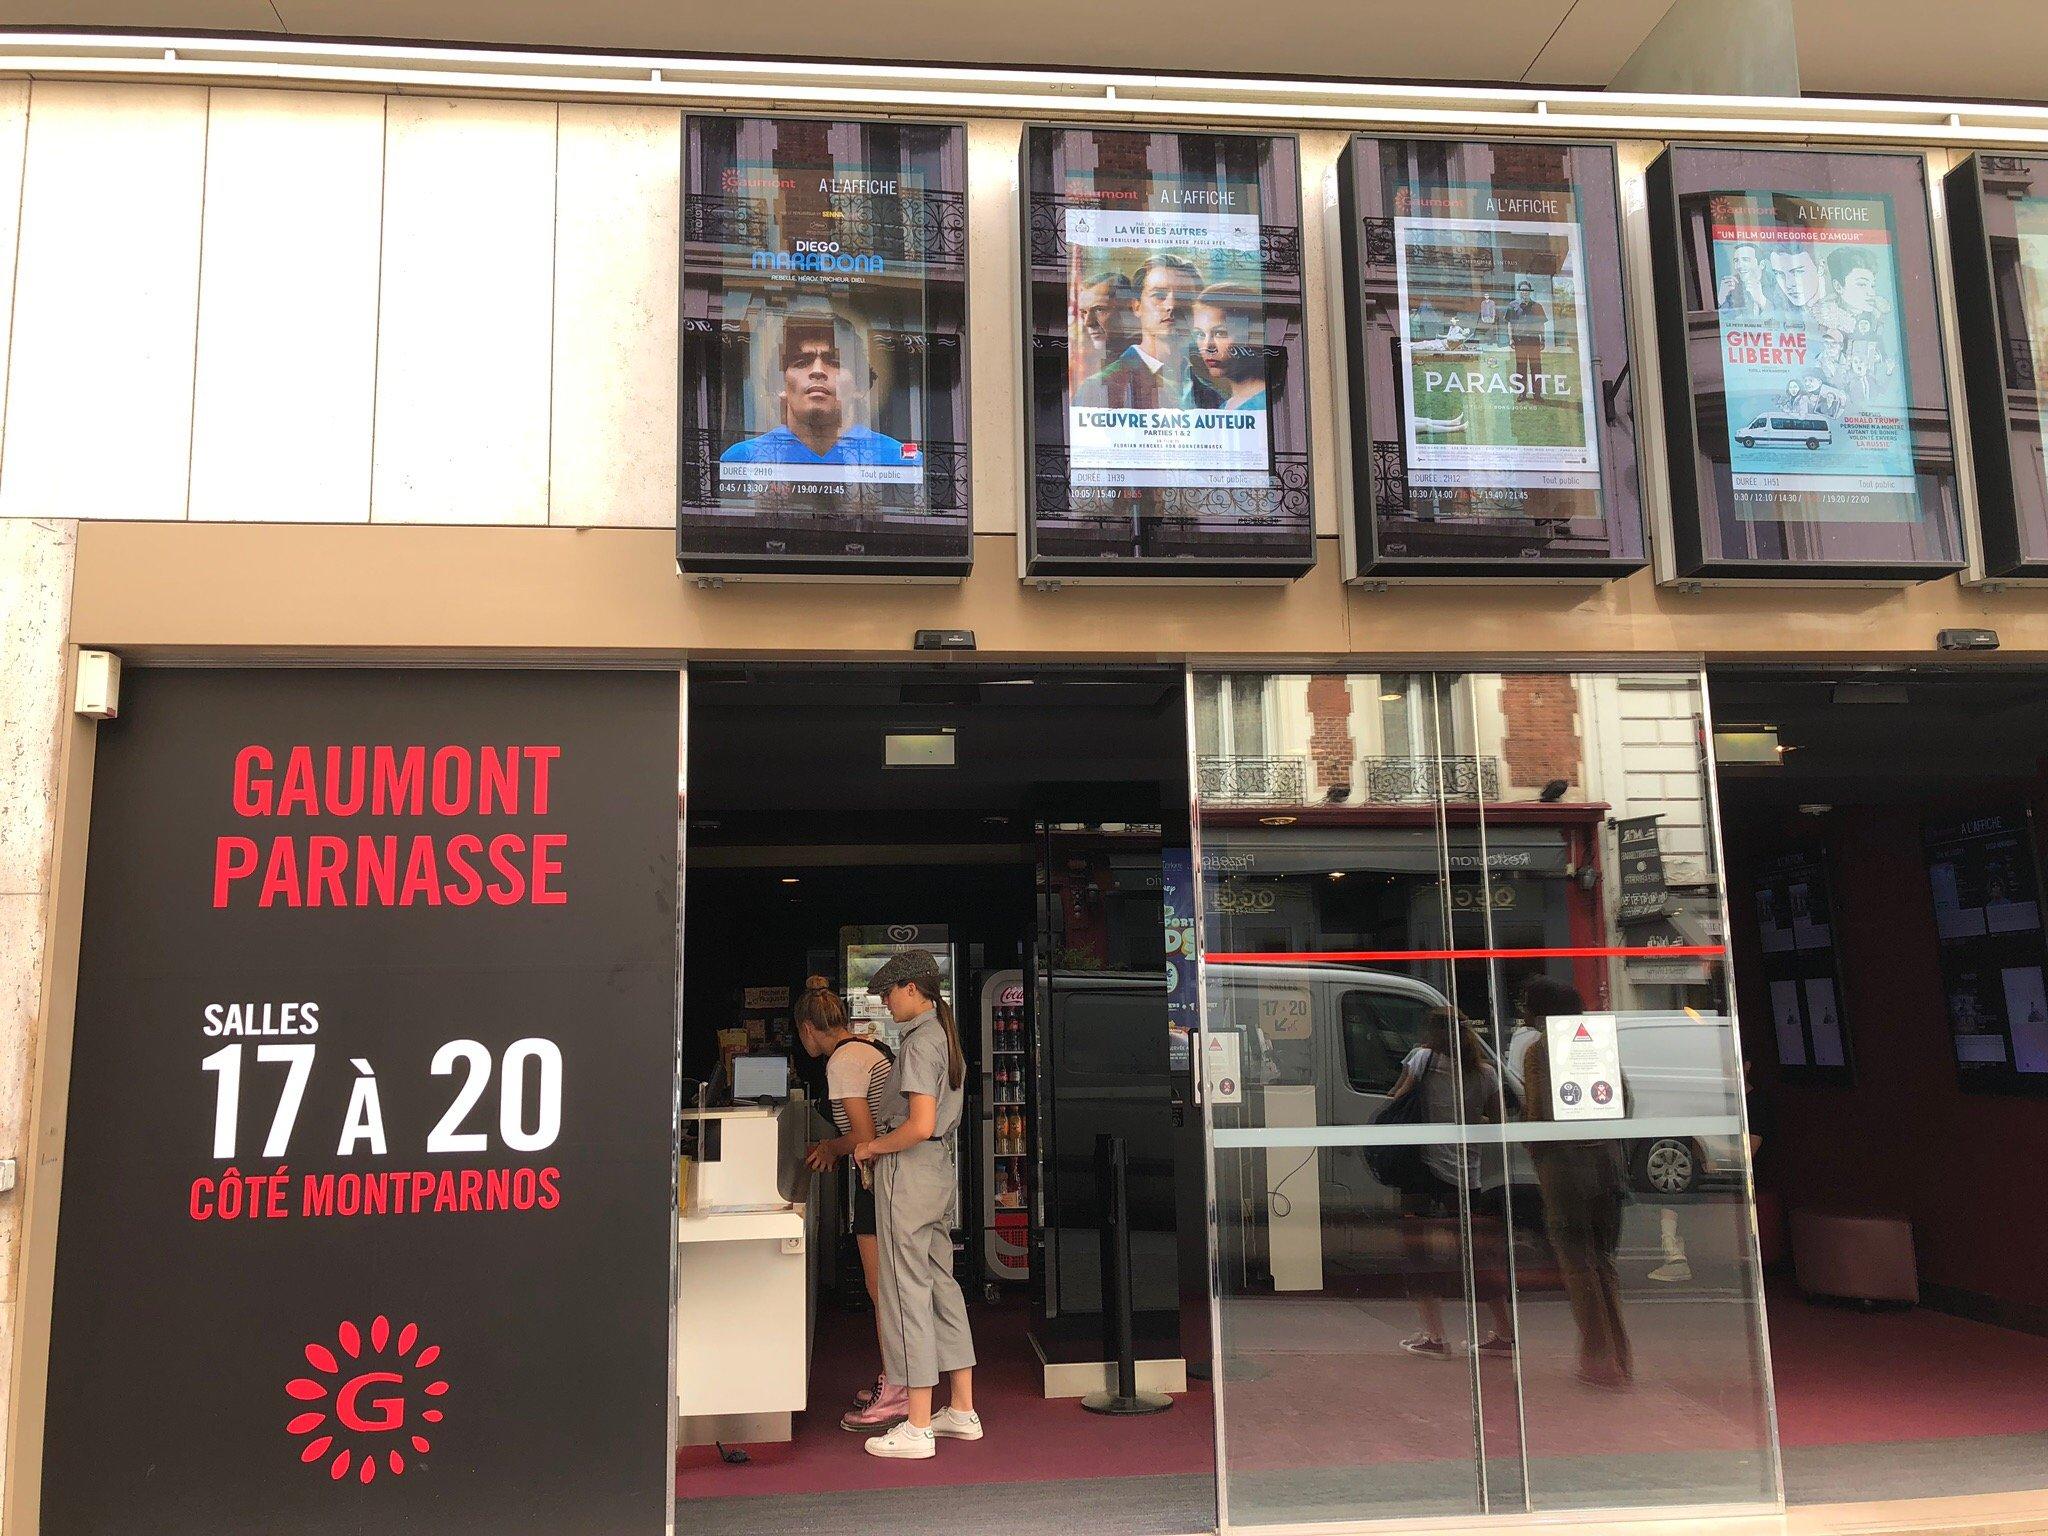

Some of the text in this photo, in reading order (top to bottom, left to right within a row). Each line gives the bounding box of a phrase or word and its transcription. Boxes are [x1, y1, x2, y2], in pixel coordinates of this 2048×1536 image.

[819, 178, 898, 195] A L'AFFICHE
[1160, 190, 1236, 206] A L'AFFICHE
[1486, 198, 1559, 214] A L'AFFICHE
[1798, 206, 1870, 222] A L'AFFICHE
[1115, 226, 1208, 237] LA VIE DES AUTRES
[1736, 231, 1758, 239] FILM
[1759, 231, 1775, 240] QUI
[1777, 231, 1818, 240] REGORGE
[796, 240, 840, 252] DIEGO
[1727, 331, 1807, 348] GIVE ME
[1728, 347, 1807, 365] LIBERTY
[1424, 371, 1571, 395] PARASITE
[1078, 412, 1256, 430] L'ŒUVRE SANS AUTEUR
[1143, 429, 1173, 437] PARTIES
[754, 467, 773, 476] 2H10
[860, 470, 901, 480] Tout public
[1107, 473, 1126, 482] 1H39
[1443, 474, 1461, 483] 2H12
[1543, 475, 1580, 485] Tout public
[797, 485, 818, 493] 19:00
[824, 485, 845, 494] 21:45
[232, 744, 561, 817] GAUMONT
[212, 833, 568, 909] PARNASSE
[202, 1001, 319, 1037] SALLES
[202, 1037, 563, 1160] 17 À 20
[189, 1165, 561, 1221] CÔTÉ MONTPARNOS
